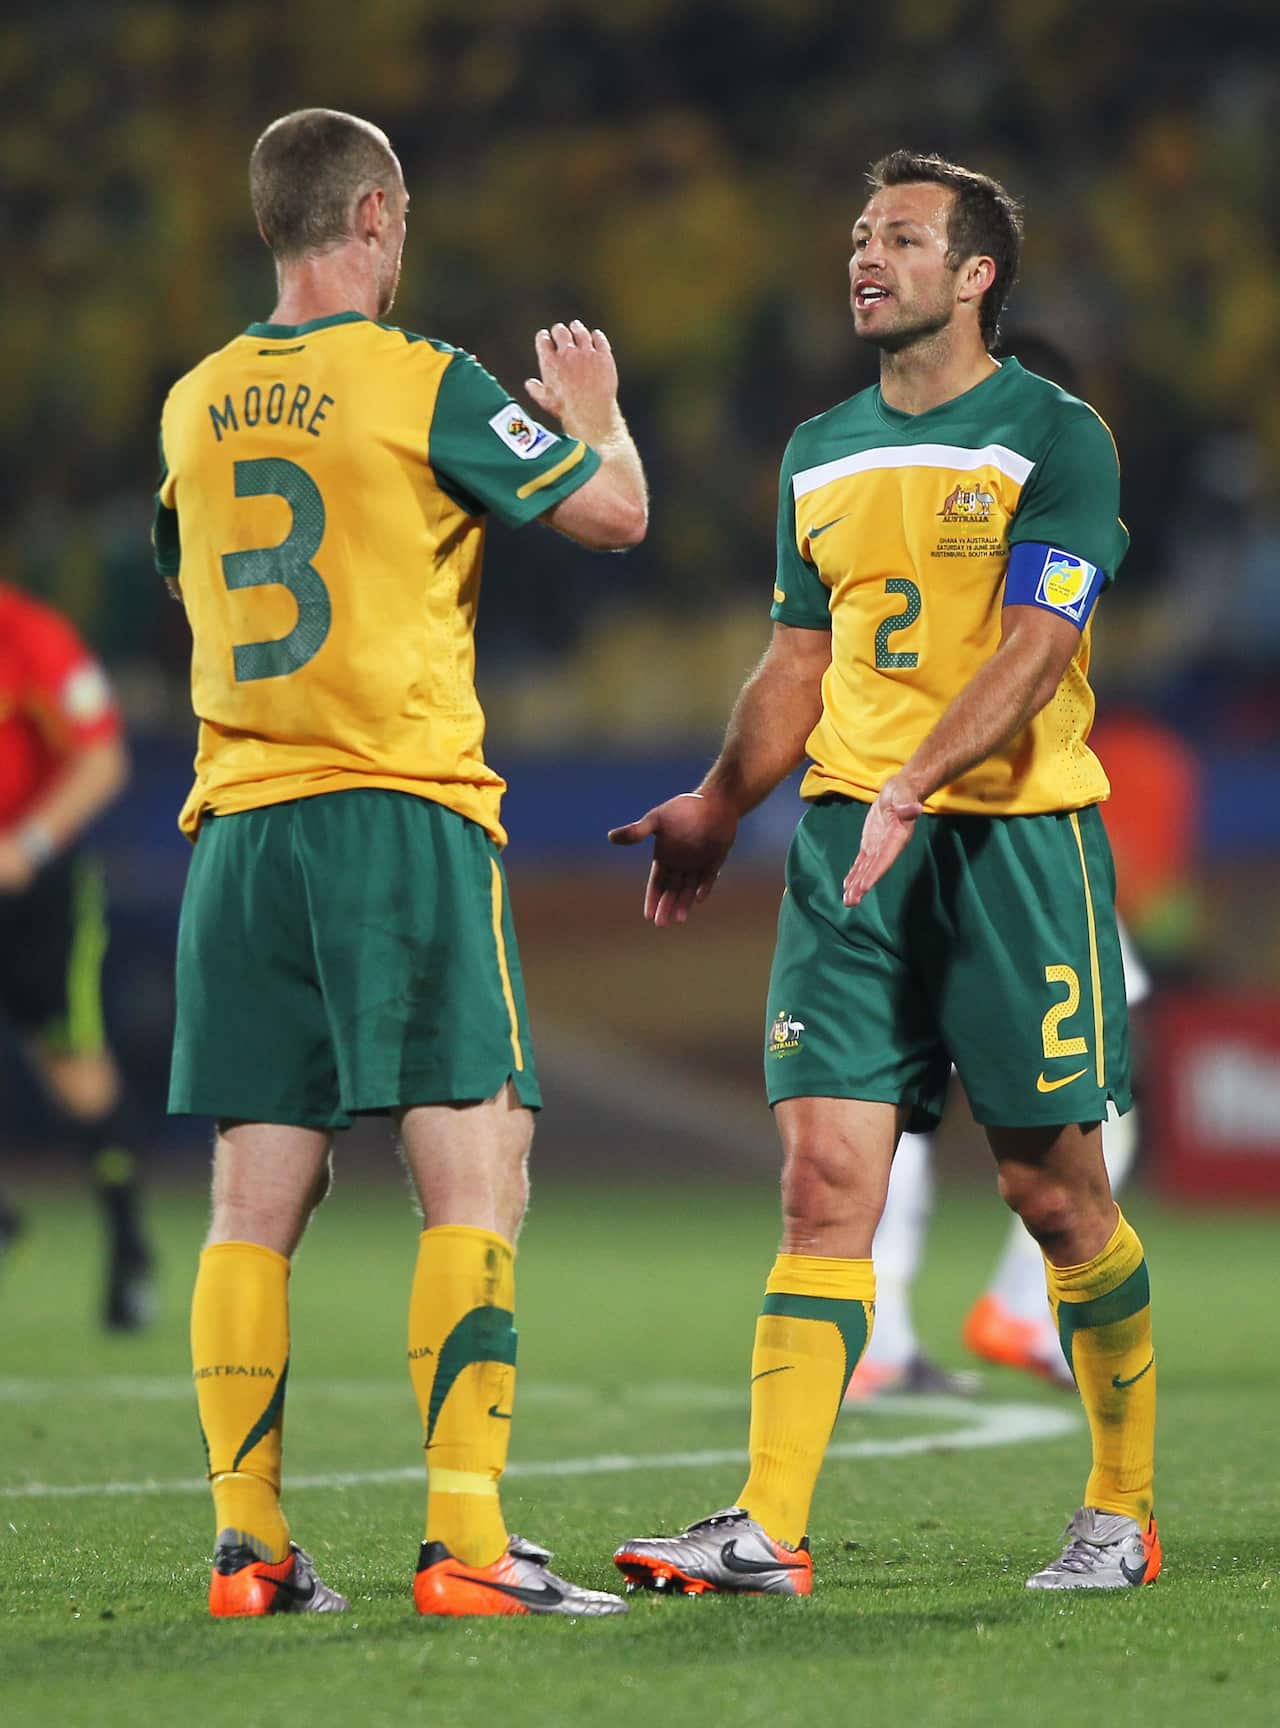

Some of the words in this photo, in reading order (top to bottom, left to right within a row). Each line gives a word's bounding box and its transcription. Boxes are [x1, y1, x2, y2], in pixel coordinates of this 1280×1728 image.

[209, 383, 335, 442] MOORE
[942, 515, 990, 523] AUSTRALIA
[221, 457, 331, 682] 3
[875, 578, 922, 669] 2
[1042, 964, 1089, 1059] 2
